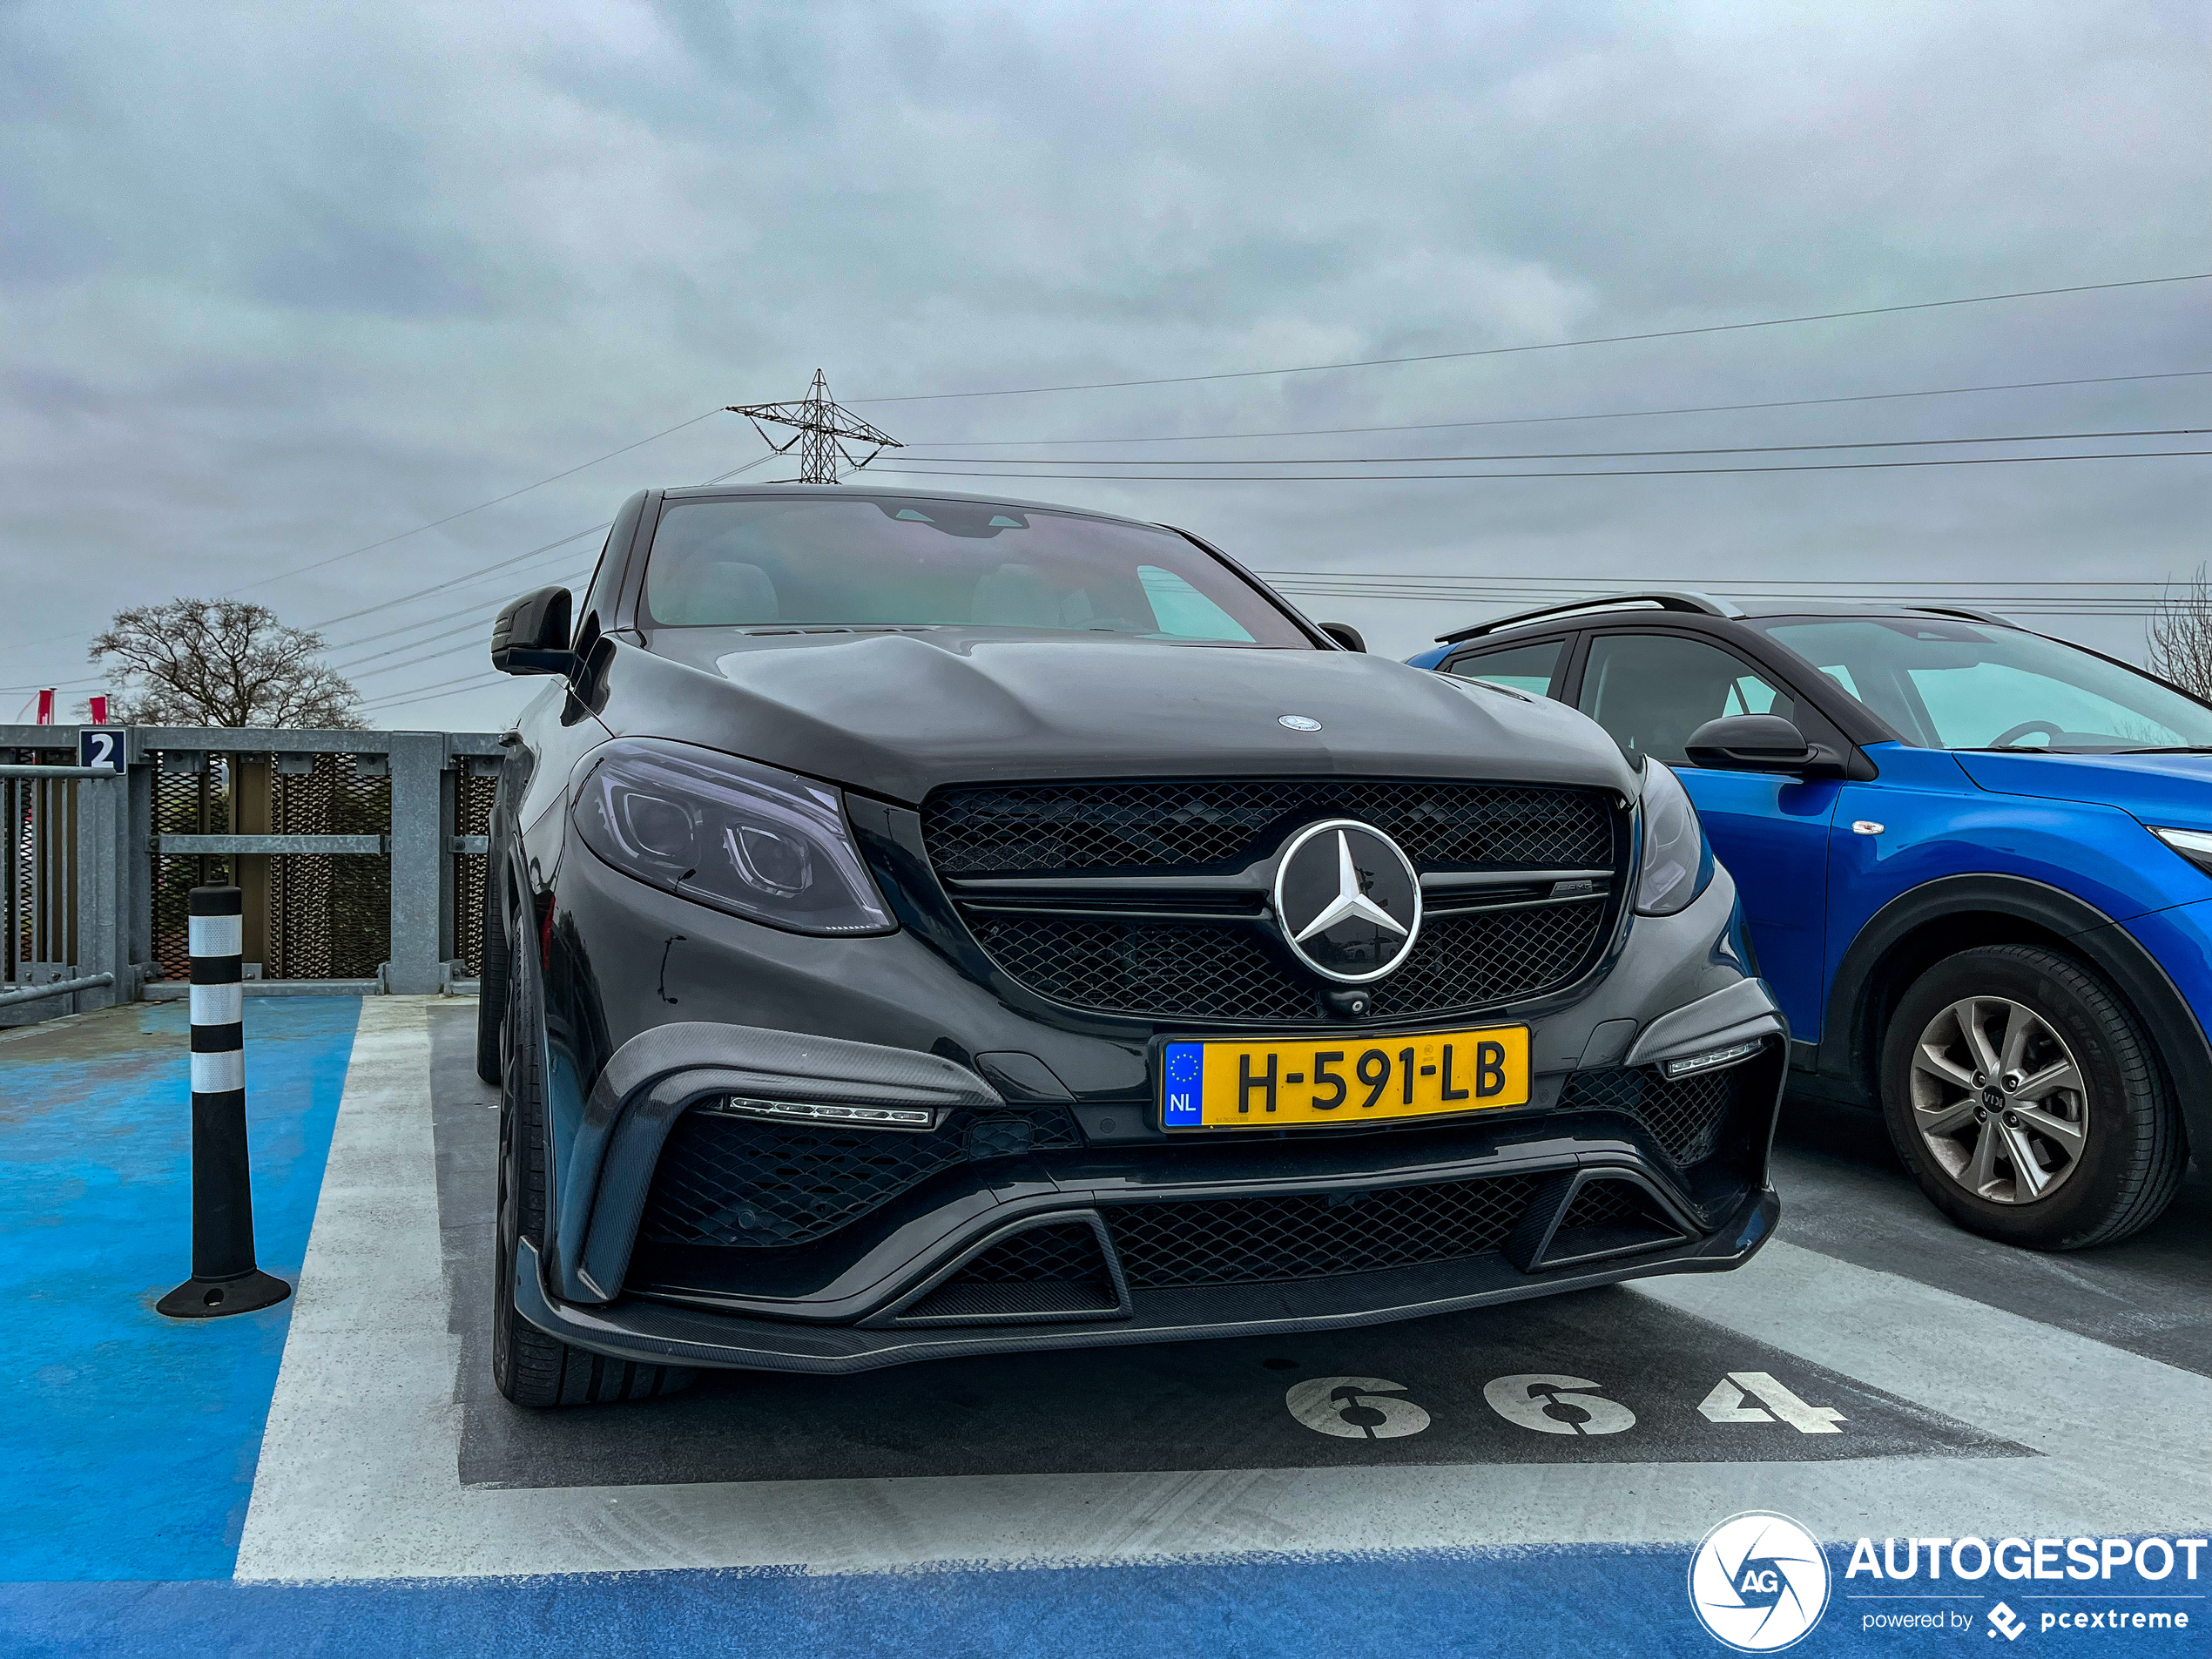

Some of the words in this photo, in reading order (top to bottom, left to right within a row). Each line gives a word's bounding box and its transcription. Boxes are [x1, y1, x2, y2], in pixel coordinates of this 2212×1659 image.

[91, 733, 114, 768] 2
[1238, 1041, 1506, 1113] H-591-LB
[1170, 1094, 1197, 1112] NL
[1984, 1091, 2003, 1108] KIA
